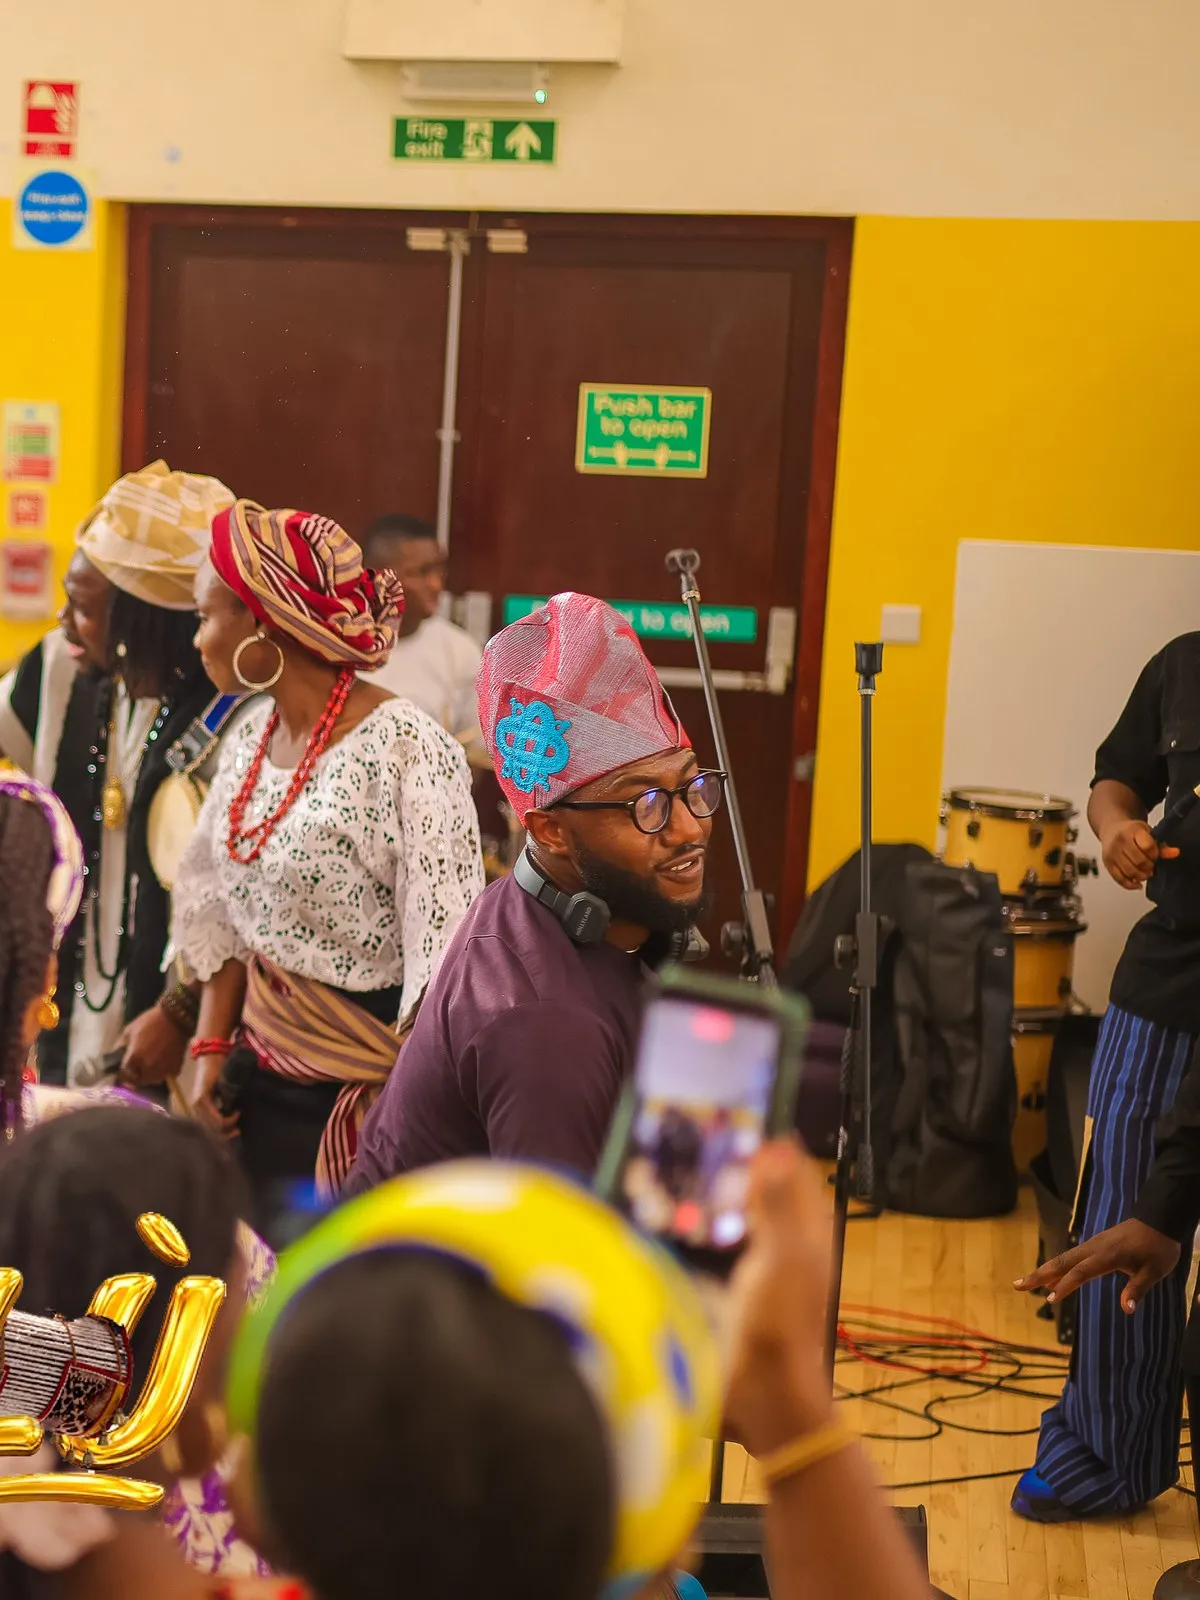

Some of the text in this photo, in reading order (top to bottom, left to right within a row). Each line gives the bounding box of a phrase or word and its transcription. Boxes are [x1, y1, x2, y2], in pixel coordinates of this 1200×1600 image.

[406, 120, 448, 140] Fire
[405, 140, 445, 158] exit
[594, 392, 697, 419] Push bar
[600, 416, 687, 441] to open
[641, 608, 665, 631] to
